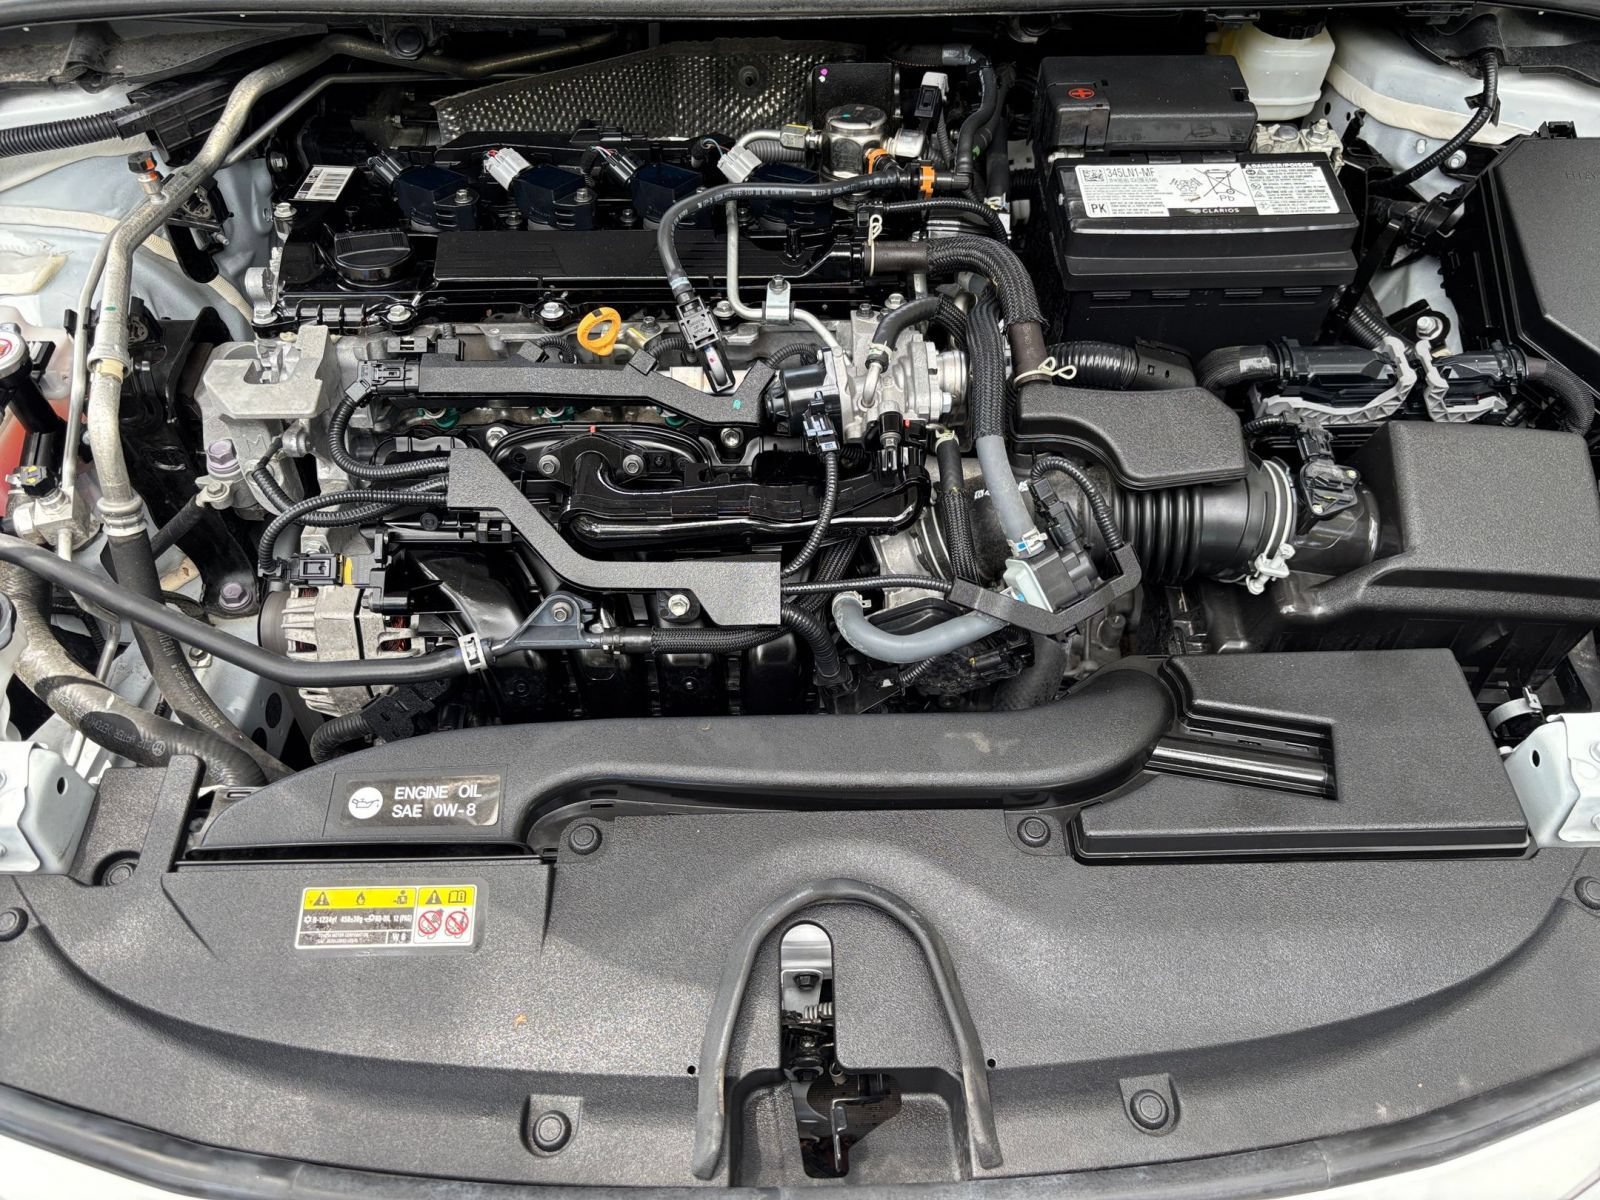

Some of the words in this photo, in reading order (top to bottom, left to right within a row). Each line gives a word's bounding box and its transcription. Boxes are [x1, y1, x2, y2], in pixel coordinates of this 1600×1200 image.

[1106, 168, 1155, 178] 345LN1-MF
[1090, 203, 1107, 214] PK
[394, 786, 449, 800] ENGINE
[458, 784, 482, 798] OIL
[392, 804, 423, 818] SAE
[434, 803, 476, 817] 0W-8
